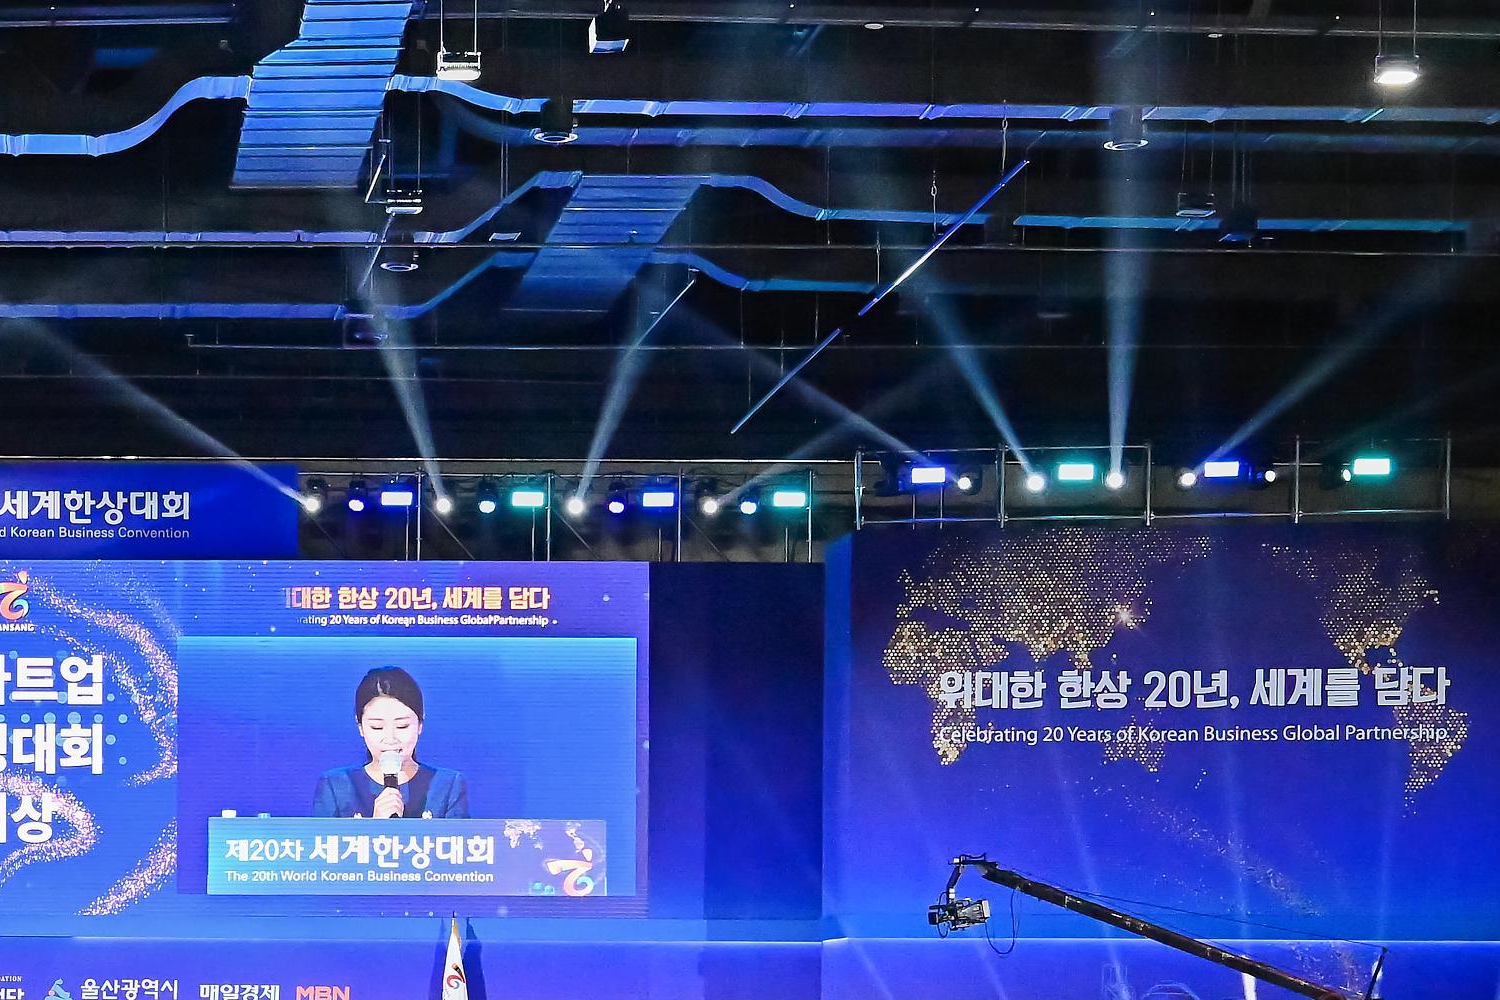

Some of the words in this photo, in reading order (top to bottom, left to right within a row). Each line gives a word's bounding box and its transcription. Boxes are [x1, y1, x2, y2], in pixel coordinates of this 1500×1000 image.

[10, 526, 55, 538] Korean
[59, 526, 115, 538] Business
[118, 527, 190, 539] Convention
[338, 586, 380, 610] 한상
[384, 586, 438, 610] 20년,
[442, 586, 503, 610] 세계를
[509, 587, 550, 610] 담다
[329, 615, 342, 625] 20
[343, 615, 368, 625] Years
[370, 614, 381, 625] of
[381, 615, 416, 626] Korean
[417, 615, 459, 625] Business
[493, 615, 549, 627] Partnership
[938, 670, 1047, 709] 위대한
[1057, 670, 1132, 709] 한상
[1143, 669, 1240, 709] 20년,
[1250, 668, 1361, 707] 세계를
[1373, 666, 1451, 706] 담다
[939, 727, 1038, 745] Celebrating
[1043, 727, 1064, 741] 20
[1067, 726, 1112, 742] Years
[1116, 726, 1136, 742] of
[1138, 726, 1199, 742] Korean
[1204, 726, 1278, 741] Business
[1283, 725, 1340, 741] Global
[1345, 725, 1448, 743] Partnership
[225, 839, 304, 862] 제20차
[309, 835, 494, 869] 세계한상대회
[225, 870, 248, 882] The
[251, 870, 278, 882] 20th
[280, 870, 317, 882] World
[321, 870, 363, 882] Korean
[367, 870, 421, 882] Business
[424, 870, 494, 882] Convention
[80, 978, 179, 1000] 울산광역시
